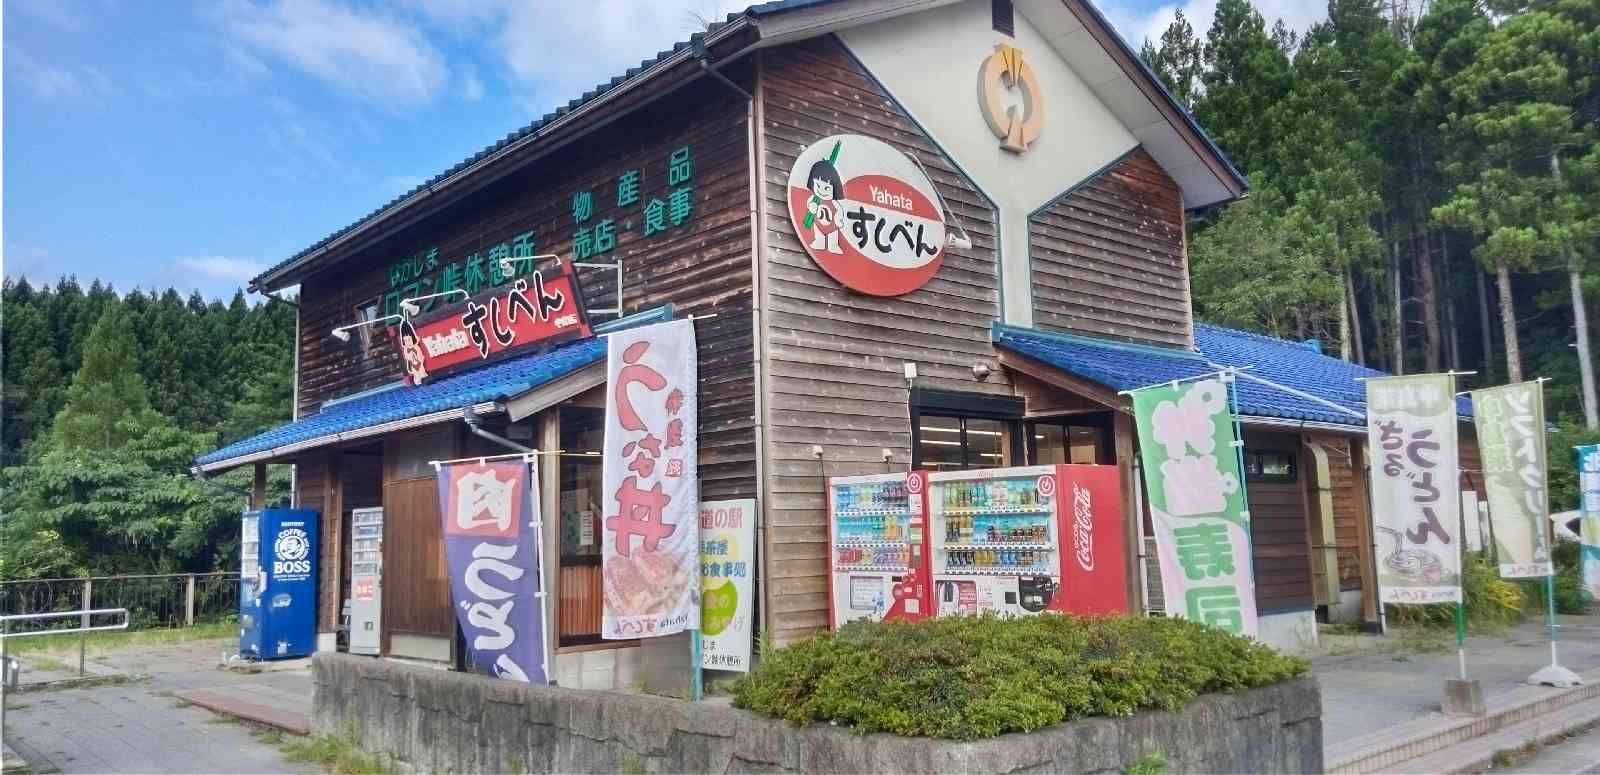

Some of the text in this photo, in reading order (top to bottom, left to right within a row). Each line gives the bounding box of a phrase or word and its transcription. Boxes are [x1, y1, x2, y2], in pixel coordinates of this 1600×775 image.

[869, 184, 913, 211] Yahata
[572, 187, 692, 258] 売店・食事
[847, 206, 938, 257] すしべん
[462, 270, 564, 359] すしべん
[699, 507, 743, 529] 道の駅
[273, 560, 311, 574] BOSS
